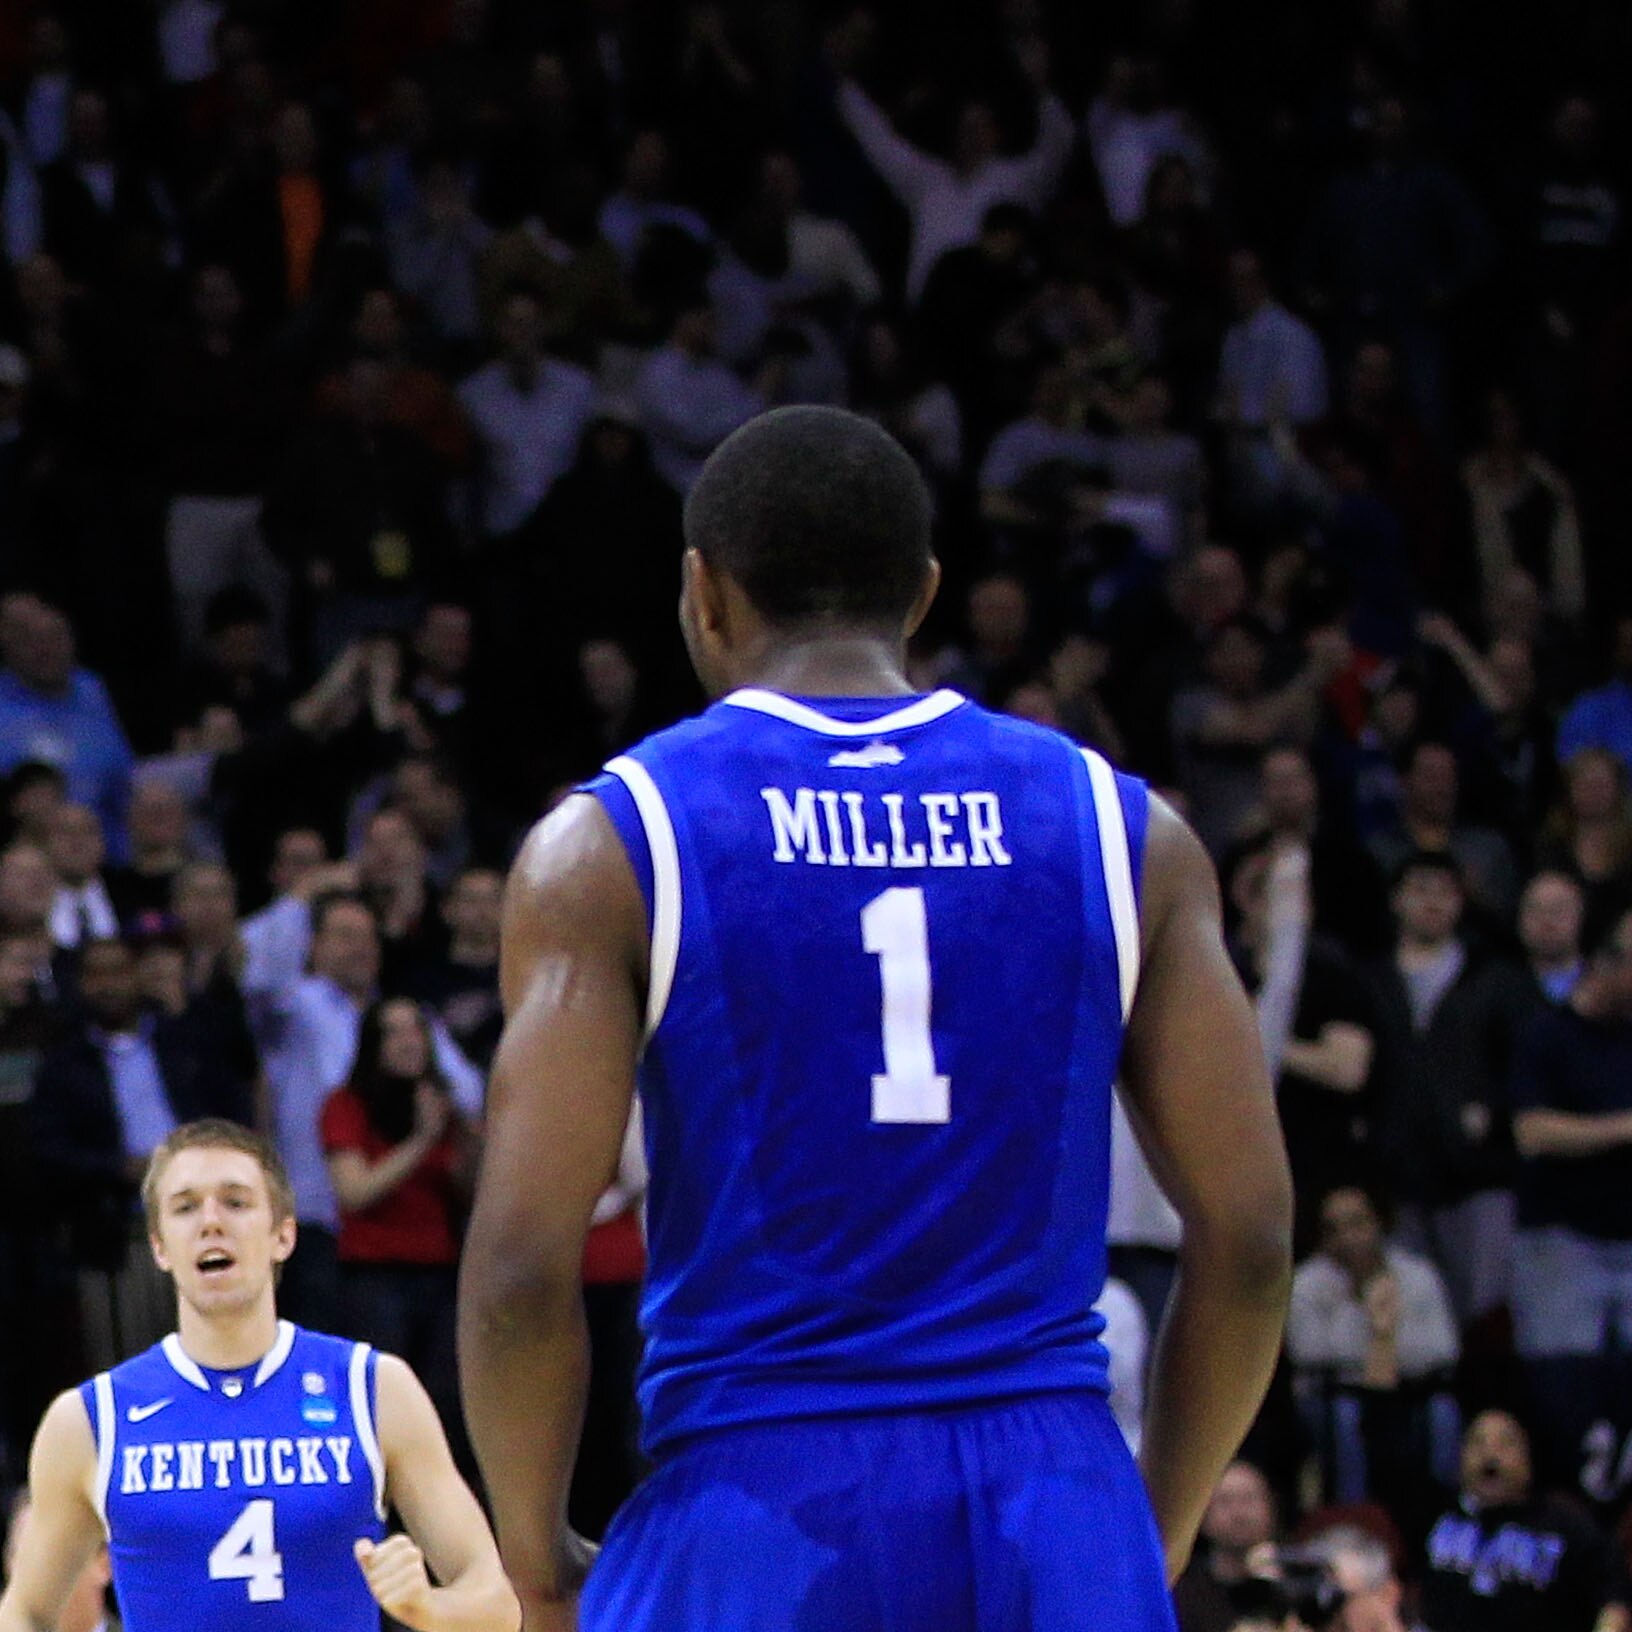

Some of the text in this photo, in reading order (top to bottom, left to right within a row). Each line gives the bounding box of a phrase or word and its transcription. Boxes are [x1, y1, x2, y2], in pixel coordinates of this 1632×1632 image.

[761, 788, 1012, 868] MILLER
[860, 887, 952, 1125] 1
[120, 1436, 355, 1494] KENTUCKY
[208, 1499, 285, 1603] 4
